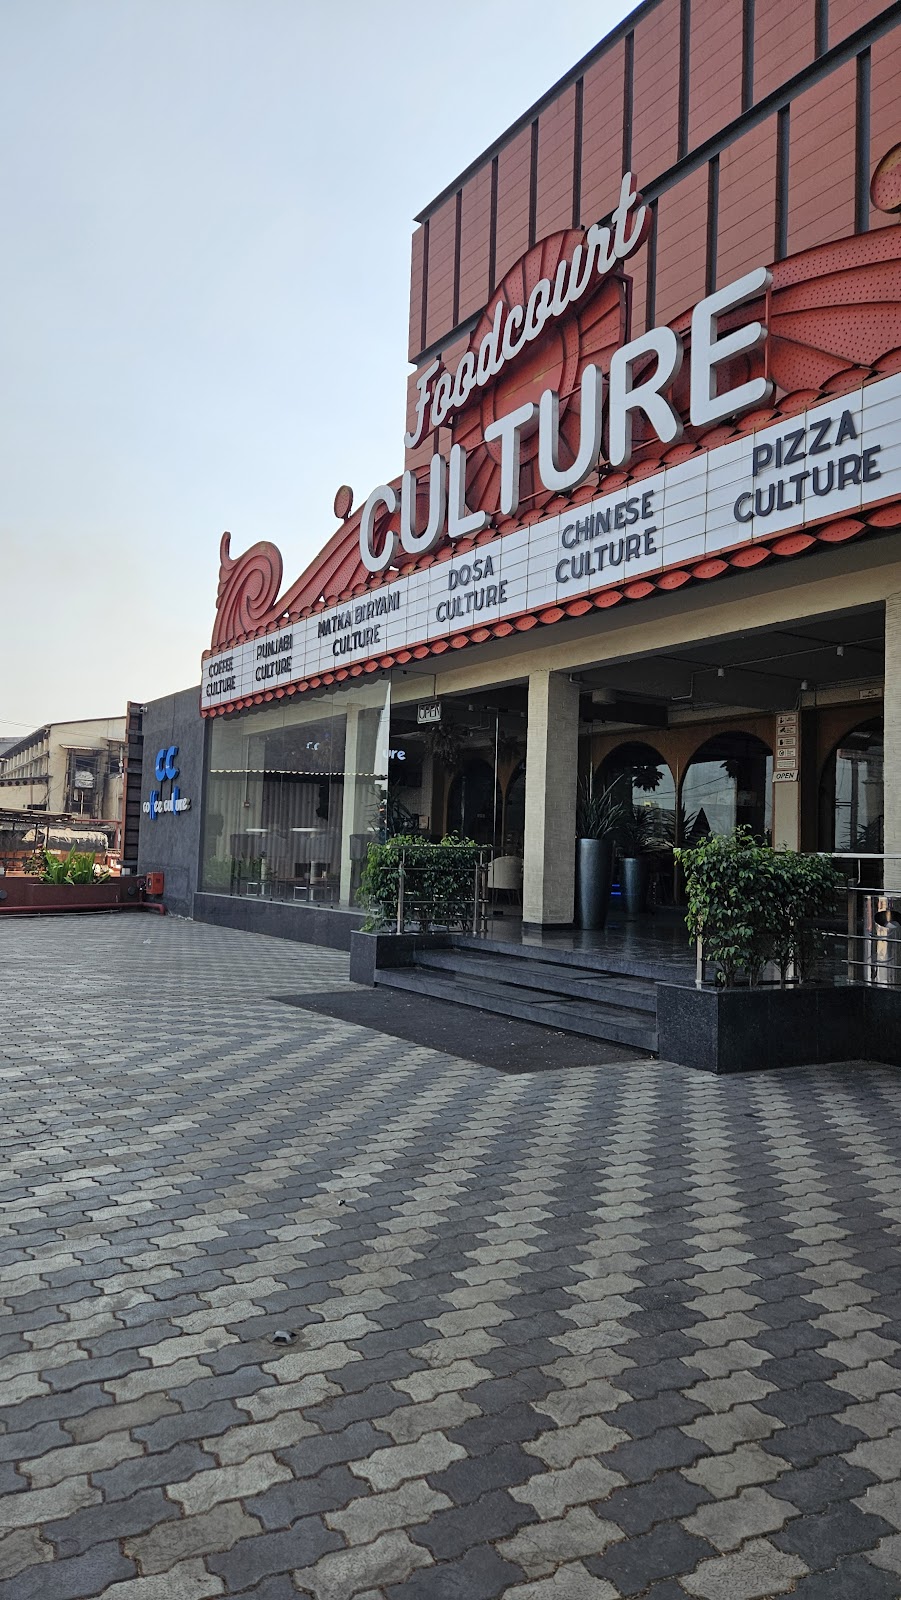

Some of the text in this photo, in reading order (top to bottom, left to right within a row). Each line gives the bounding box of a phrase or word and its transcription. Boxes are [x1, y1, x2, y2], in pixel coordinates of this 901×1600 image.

[404, 171, 650, 450] Foodcourt
[360, 266, 774, 573] CULTURE
[752, 409, 858, 477] PIZZA
[733, 444, 882, 523] CULTURE
[561, 490, 655, 550] CHINESE
[448, 555, 494, 590] DOSA
[555, 525, 658, 583] CULTURE
[317, 591, 401, 639] MATKA BIRYANI
[435, 580, 508, 623] CULTURE
[256, 633, 293, 661] PUNJABI
[332, 623, 381, 657] CULTURE
[206, 675, 236, 697] CULTURE
[208, 656, 234, 679] COFFEE
[255, 656, 293, 682] CULTURE
[776, 772, 795, 780] OPEN
[143, 790, 163, 820] coffee
